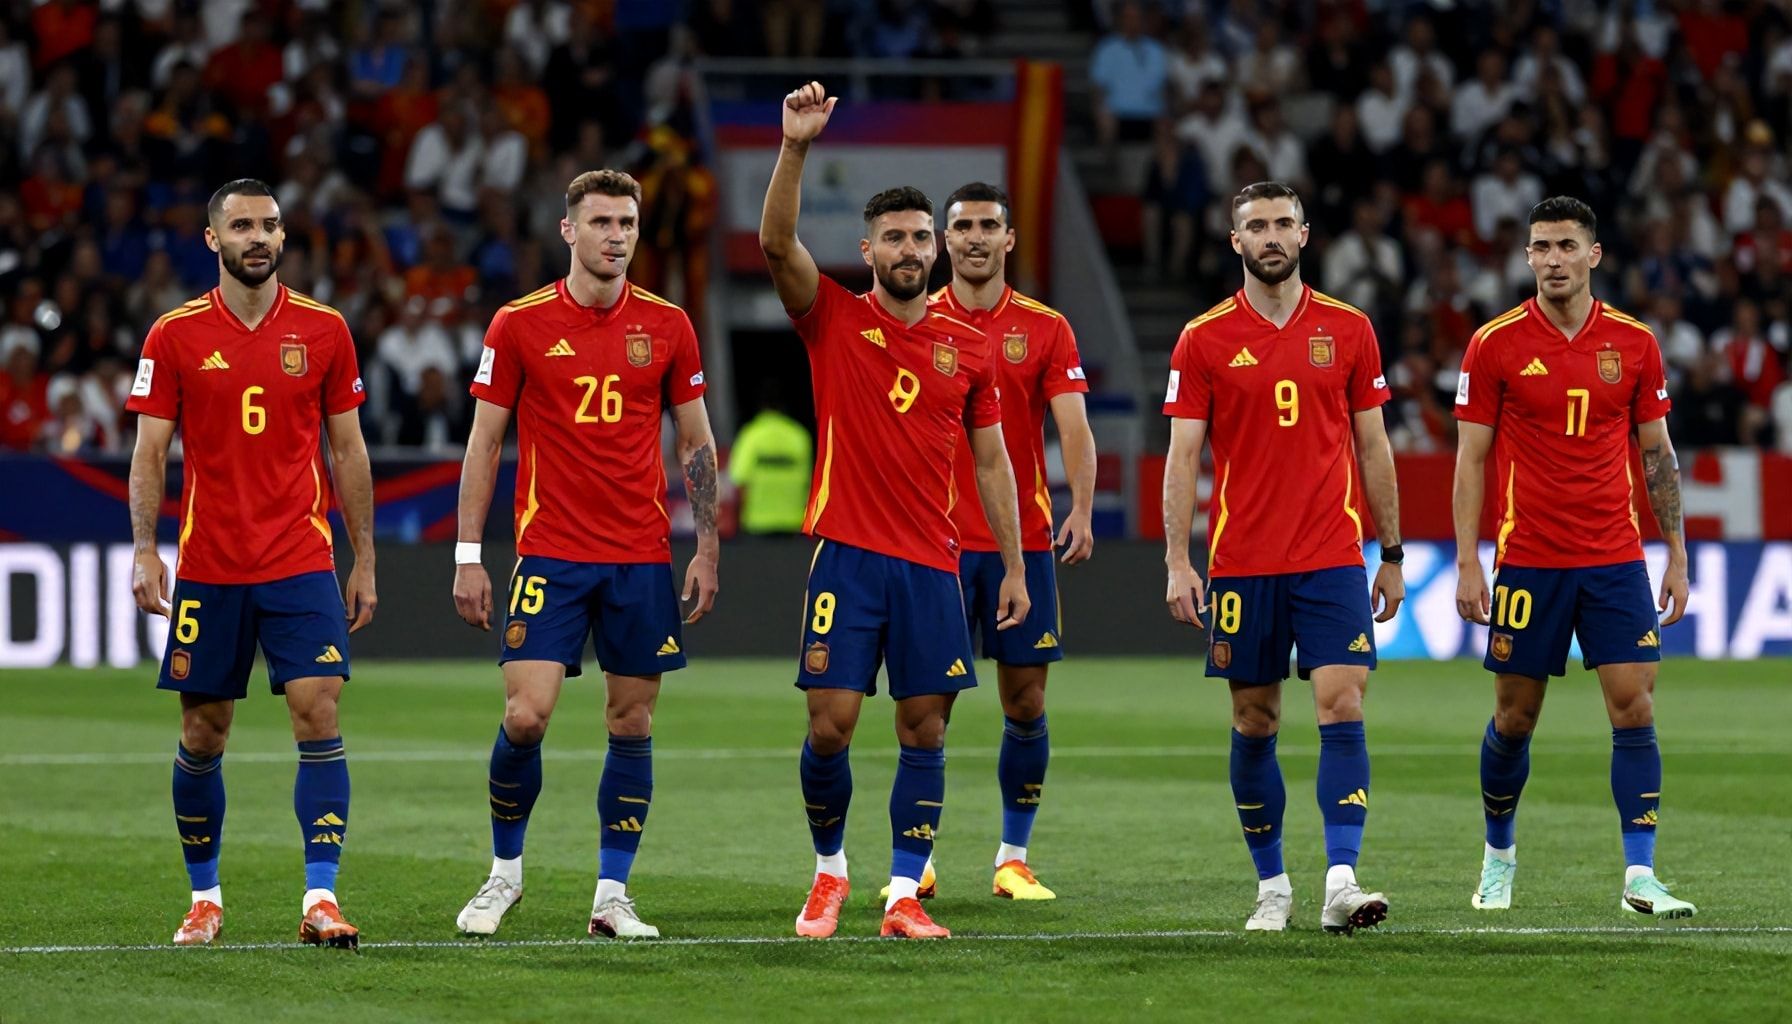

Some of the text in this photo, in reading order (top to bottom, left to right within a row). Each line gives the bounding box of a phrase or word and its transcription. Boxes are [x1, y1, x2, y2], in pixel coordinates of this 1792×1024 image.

[241, 386, 266, 435] 6
[574, 374, 623, 424] 26
[1275, 379, 1299, 427] 9
[509, 575, 547, 616] 15
[812, 591, 836, 635] 8
[1495, 585, 1533, 630] 10
